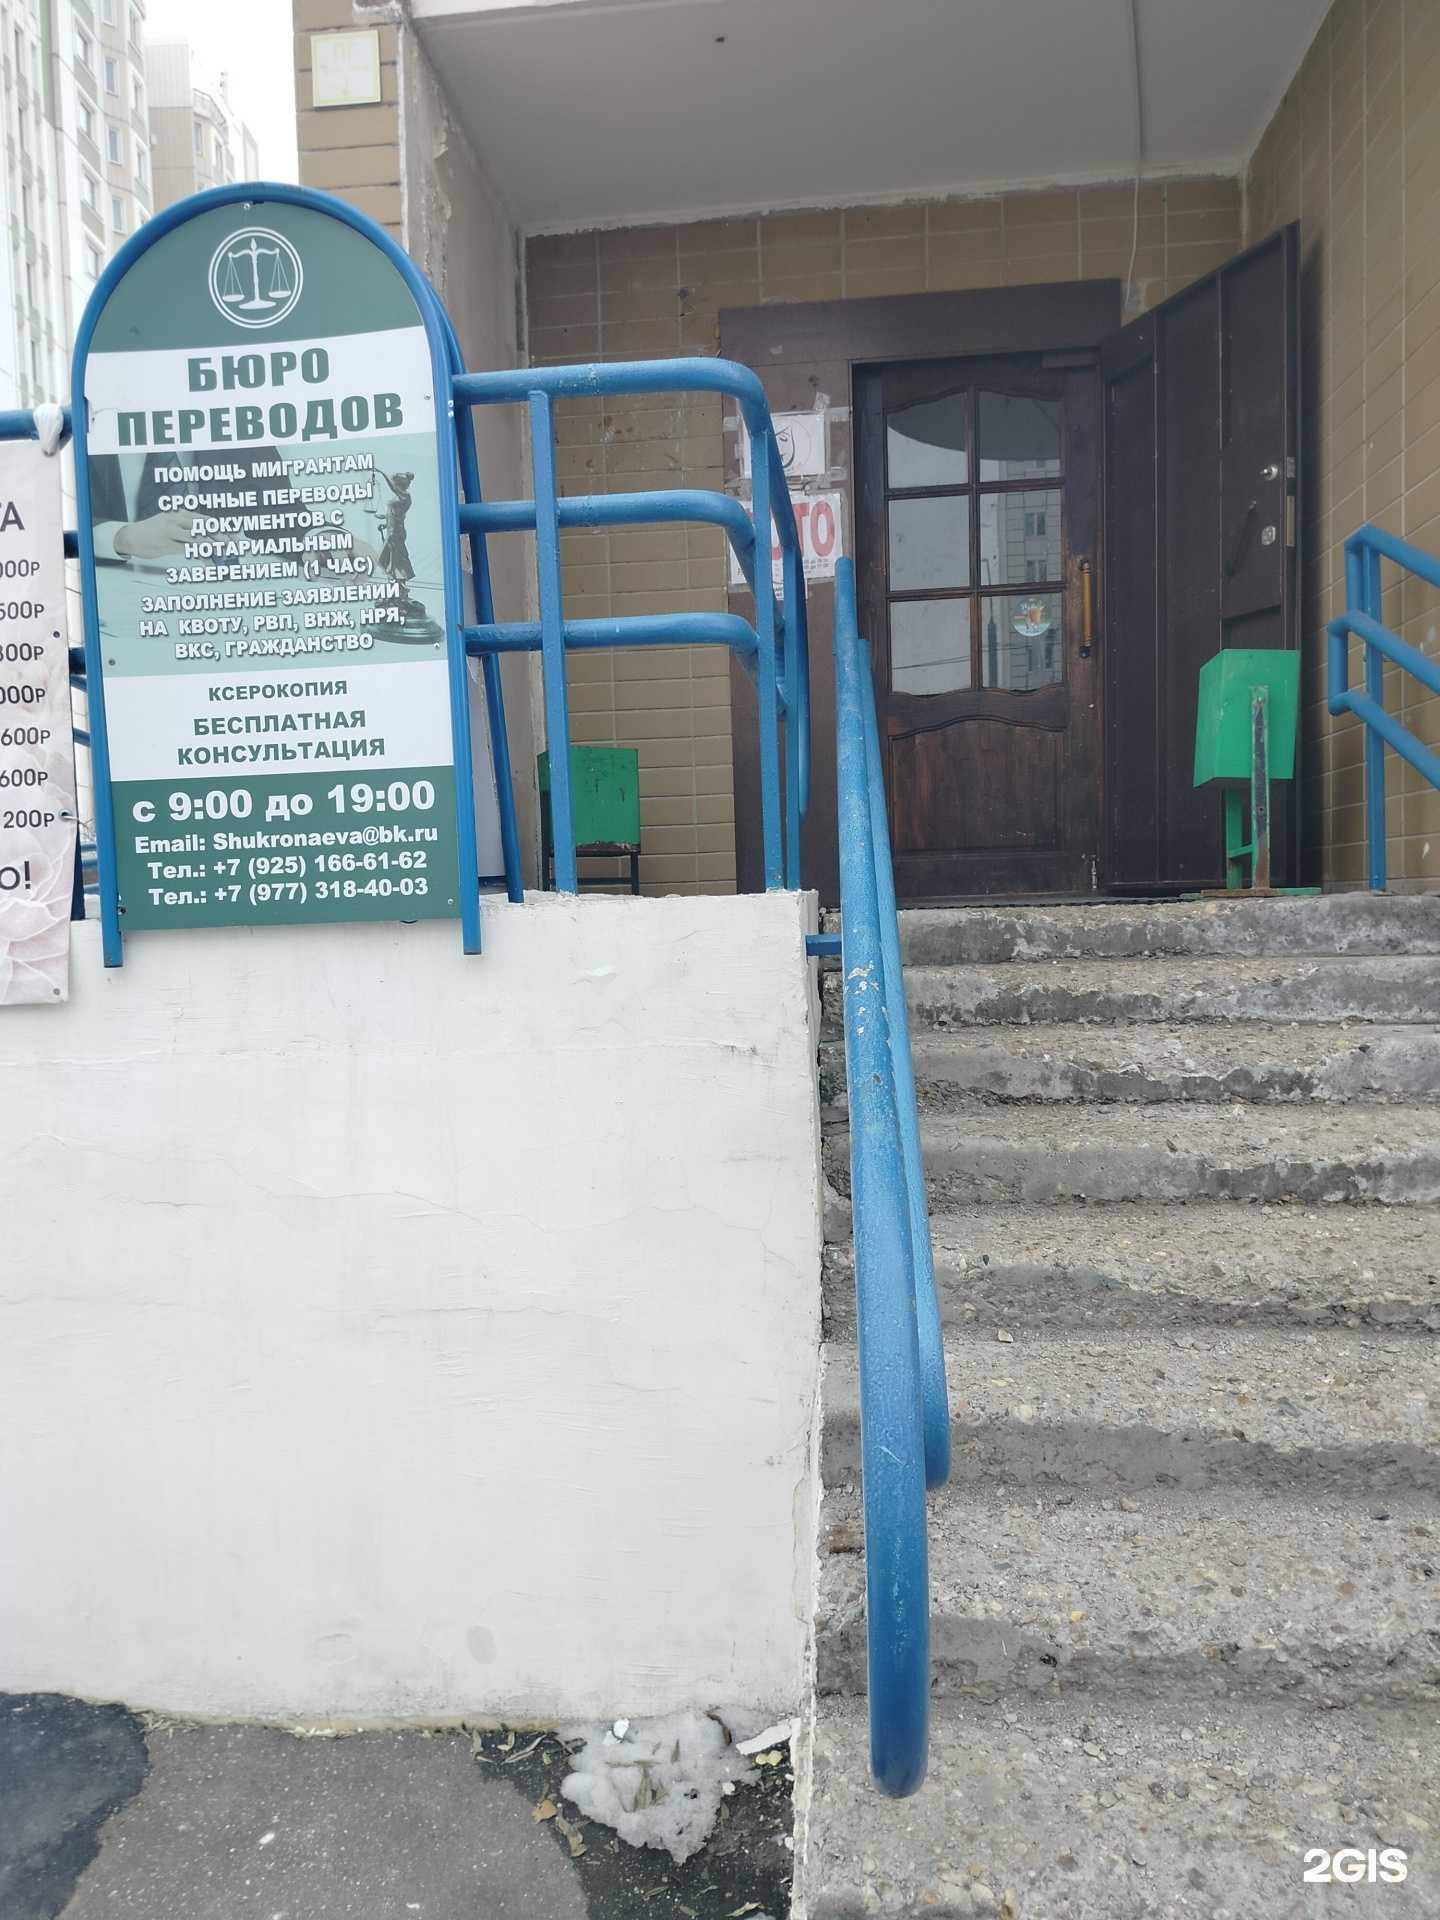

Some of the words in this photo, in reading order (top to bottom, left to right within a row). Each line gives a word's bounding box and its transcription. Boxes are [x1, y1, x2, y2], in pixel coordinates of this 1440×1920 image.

[187, 347, 330, 392] БЮРО
[117, 392, 404, 447] ПЕРЕВОДОВ
[154, 462, 246, 484] ПОМОЩЬ
[252, 454, 373, 475] МИГРАНТАМ
[158, 491, 258, 512] СРОЧНЫЕ
[263, 483, 373, 506] ПЕРЕВОДЫ
[0, 501, 25, 532] А
[191, 512, 325, 536] ДОКУМЕНТОВ
[331, 509, 343, 525] С
[185, 533, 353, 559] НОТАРИАЛЬНЫМ
[167, 561, 298, 584] ЗАВЕРЕНИЕМ
[303, 560, 321, 580] (1
[326, 557, 373, 576] ЧАС)
[142, 591, 277, 613] ЗАПОЛНЕНИЕ
[282, 579, 400, 607] ЗАЯВЛЕНИЙ
[139, 621, 168, 637] НА
[179, 616, 248, 635] КВОТУ,
[254, 613, 298, 632] РВП,
[304, 611, 355, 629] ВНЖ,
[360, 607, 405, 626] НРЯ,
[175, 642, 220, 660] ВКС,
[225, 633, 373, 657] ГРАЖДАНСТВО
[209, 680, 348, 701] КСЕРОКОПИЯ
[194, 710, 366, 736] БЕСПЛАТНАЯ
[178, 738, 386, 766] КОНСУЛЬТАЦИЯ
[132, 800, 156, 822] с
[168, 789, 252, 821] 9:00
[265, 792, 313, 821] до
[327, 781, 436, 814] 19:00
[135, 834, 206, 854] Email:
[213, 826, 438, 851] Shukronaeva@bk.ru
[148, 861, 206, 880] Тел.:
[214, 859, 241, 876] +7
[248, 856, 306, 879] (925)
[314, 851, 428, 872] 166-61-62
[149, 888, 207, 906] Тел.:
[214, 885, 241, 902] +7
[249, 882, 308, 906] (977)
[316, 878, 428, 899] 318-40-03
